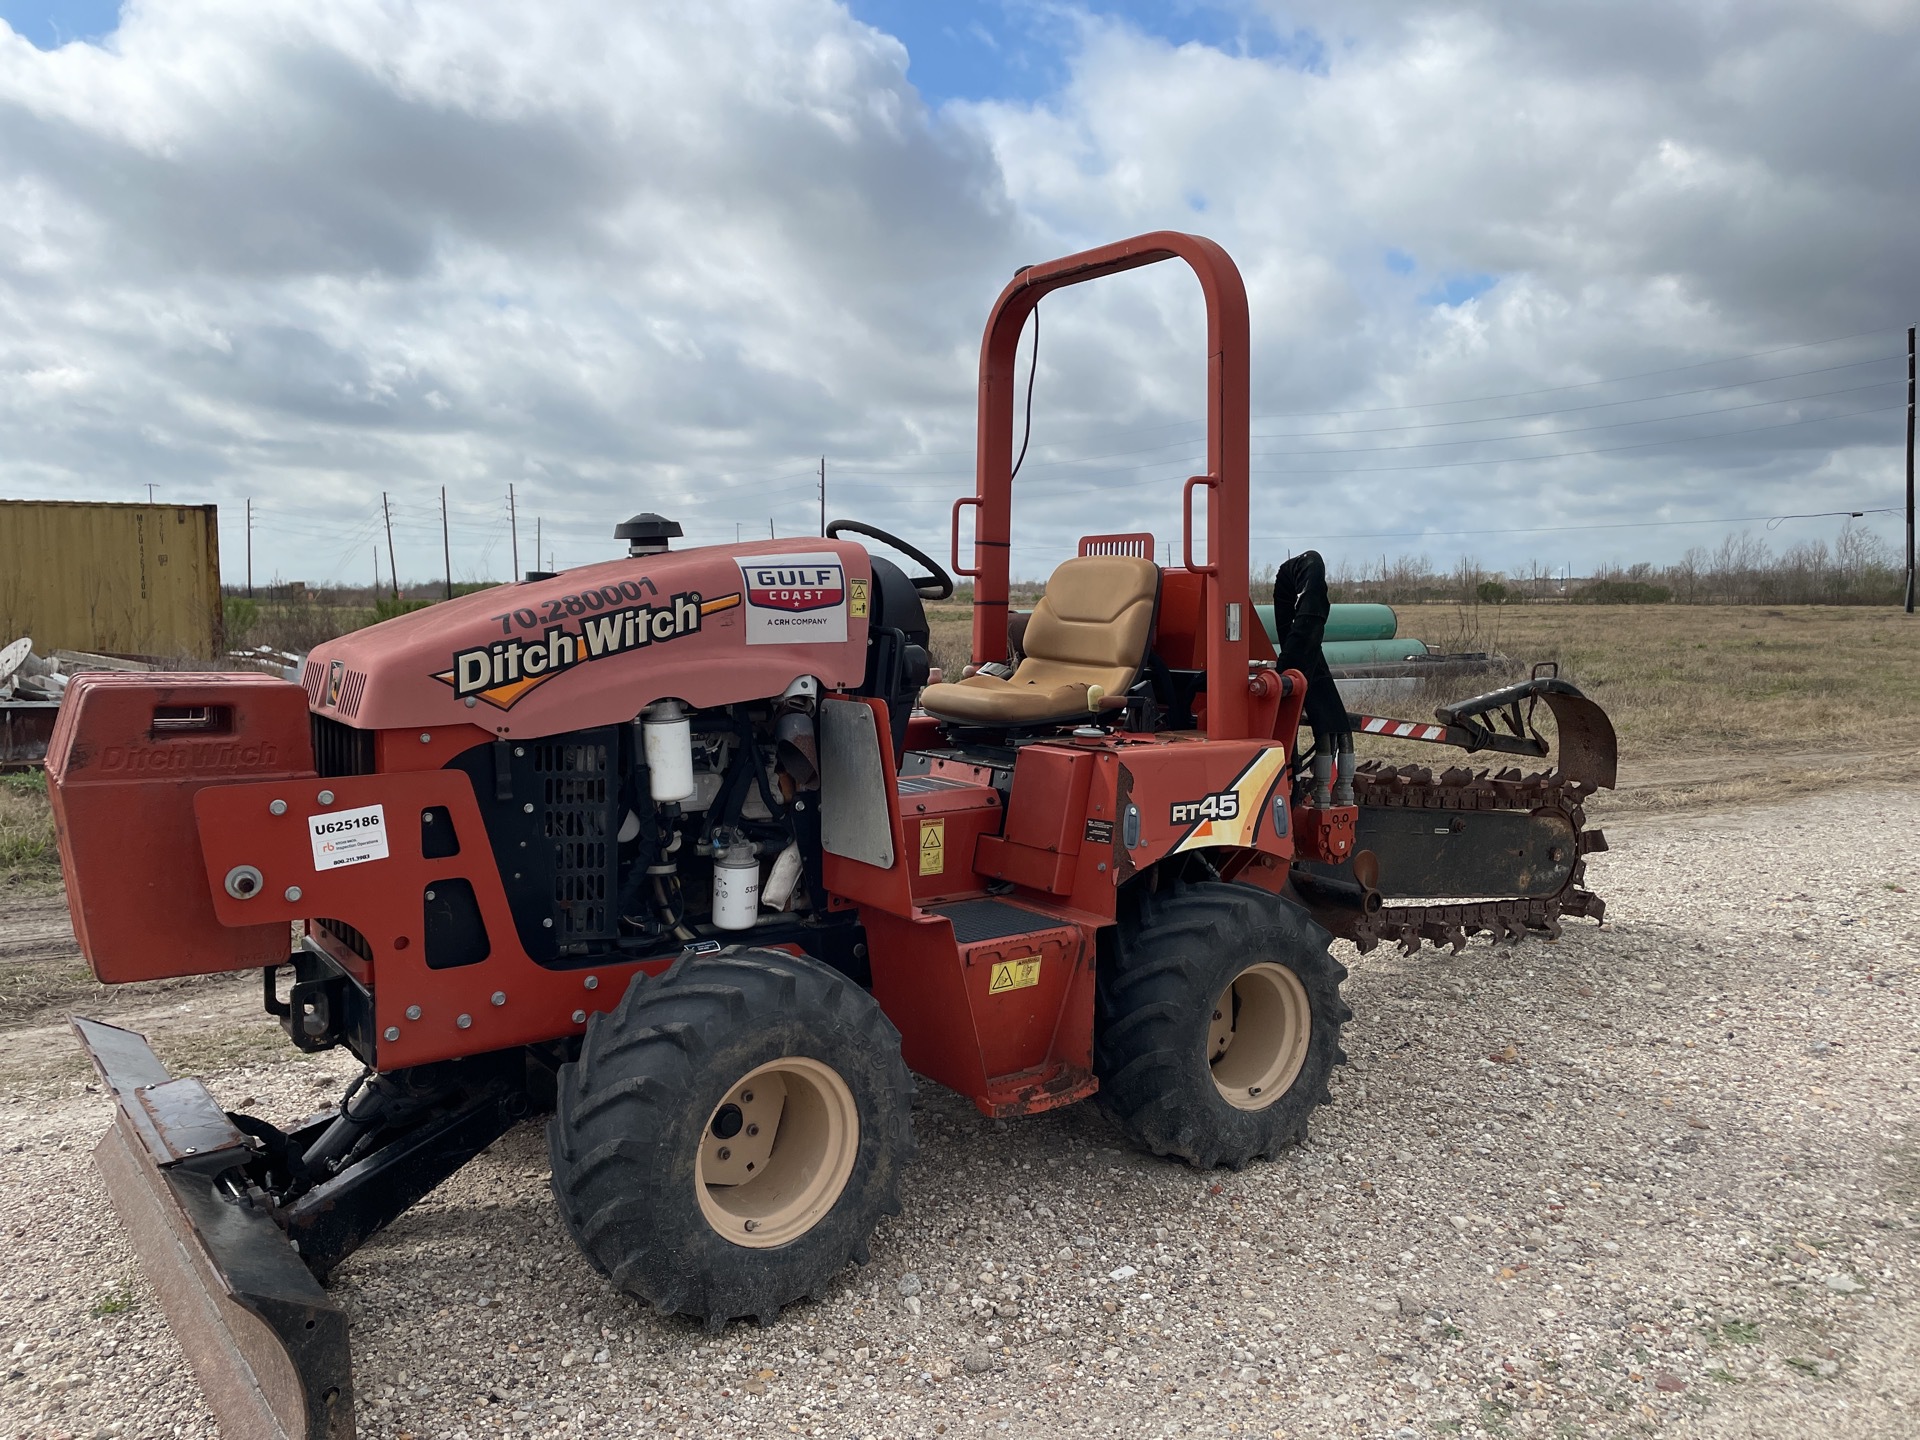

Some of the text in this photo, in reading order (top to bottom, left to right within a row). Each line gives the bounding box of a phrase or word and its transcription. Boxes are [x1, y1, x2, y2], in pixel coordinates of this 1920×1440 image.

[757, 570, 831, 586] GULF
[491, 576, 659, 635] 70.280001
[769, 590, 823, 600] COAST
[774, 618, 790, 626] CRH
[791, 618, 828, 626] COMPANY
[458, 630, 574, 694] Ditch
[100, 740, 279, 772] Ditch Witch
[1172, 794, 1238, 822] RT45
[315, 815, 380, 836] U625186
